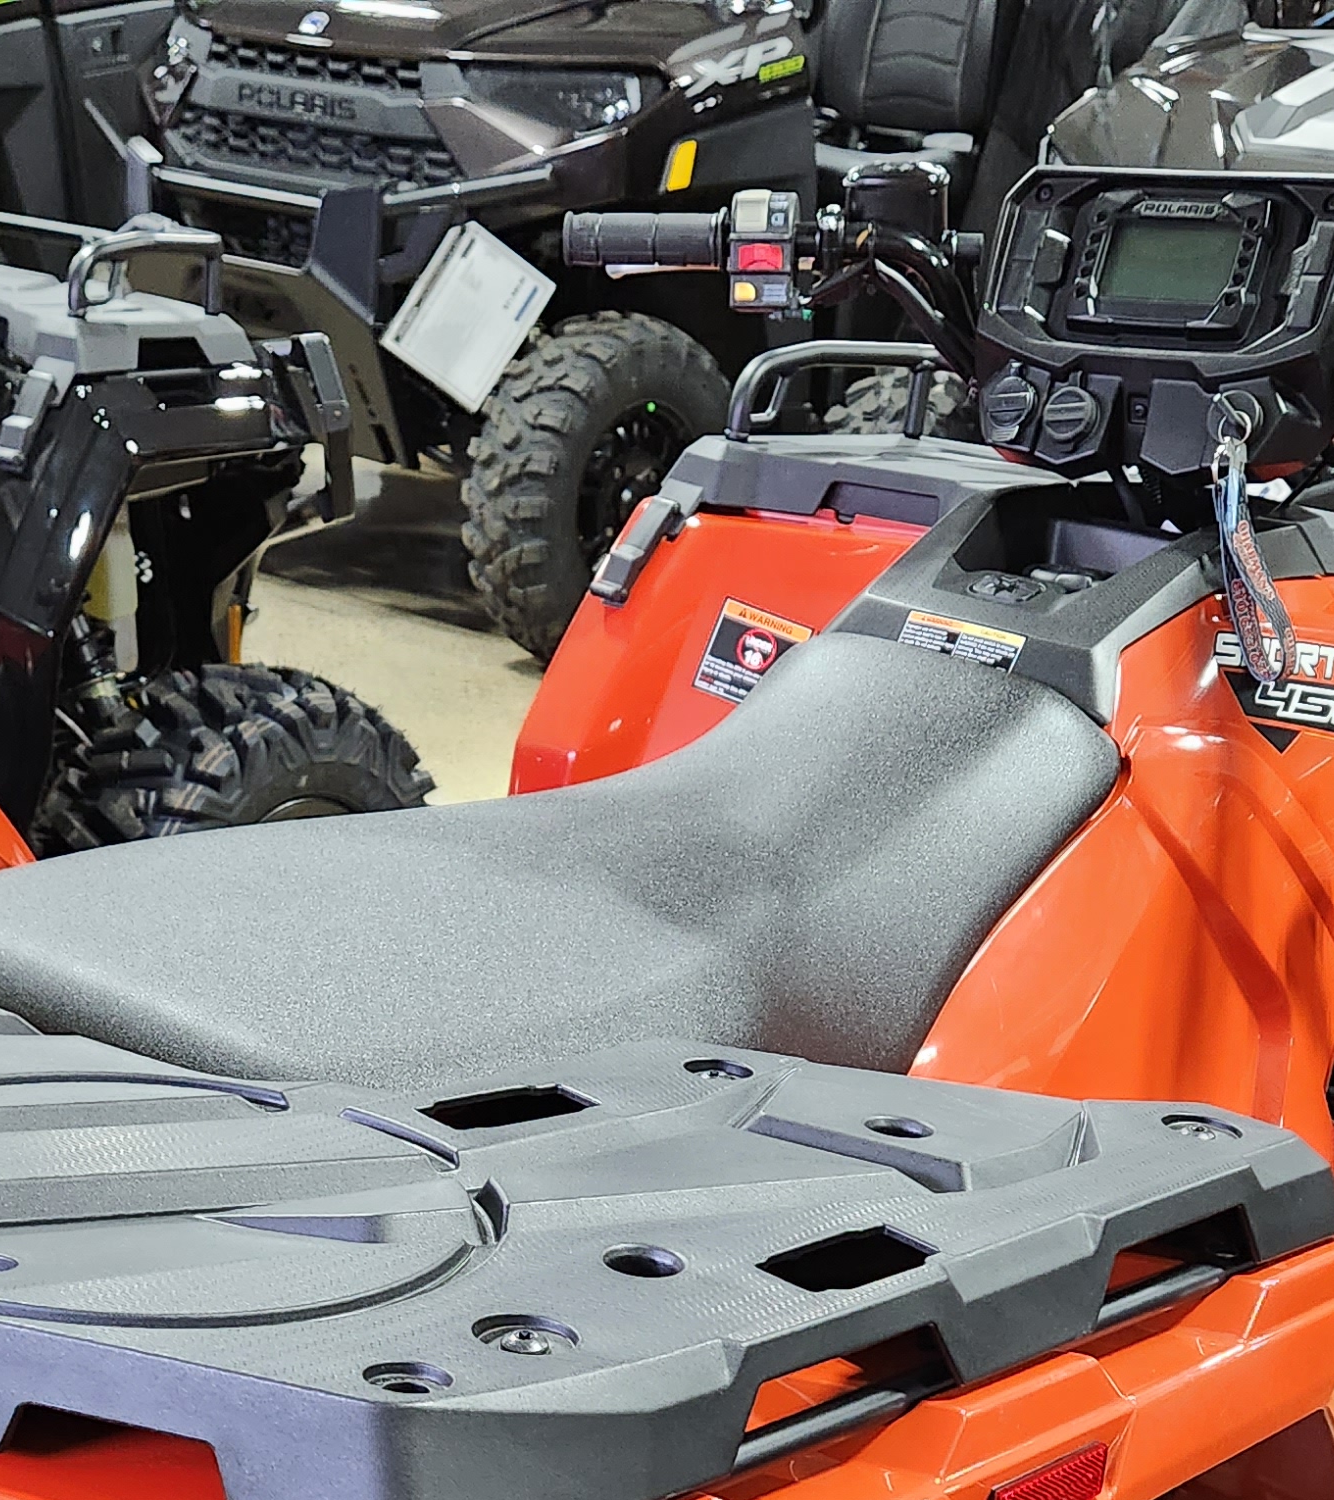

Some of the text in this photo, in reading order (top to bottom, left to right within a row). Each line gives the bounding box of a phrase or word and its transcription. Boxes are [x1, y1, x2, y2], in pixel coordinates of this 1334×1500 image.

[685, 36, 794, 98] XP
[238, 82, 357, 120] POLARIS
[1143, 203, 1217, 215] POLARIS
[749, 612, 793, 635] WARNING
